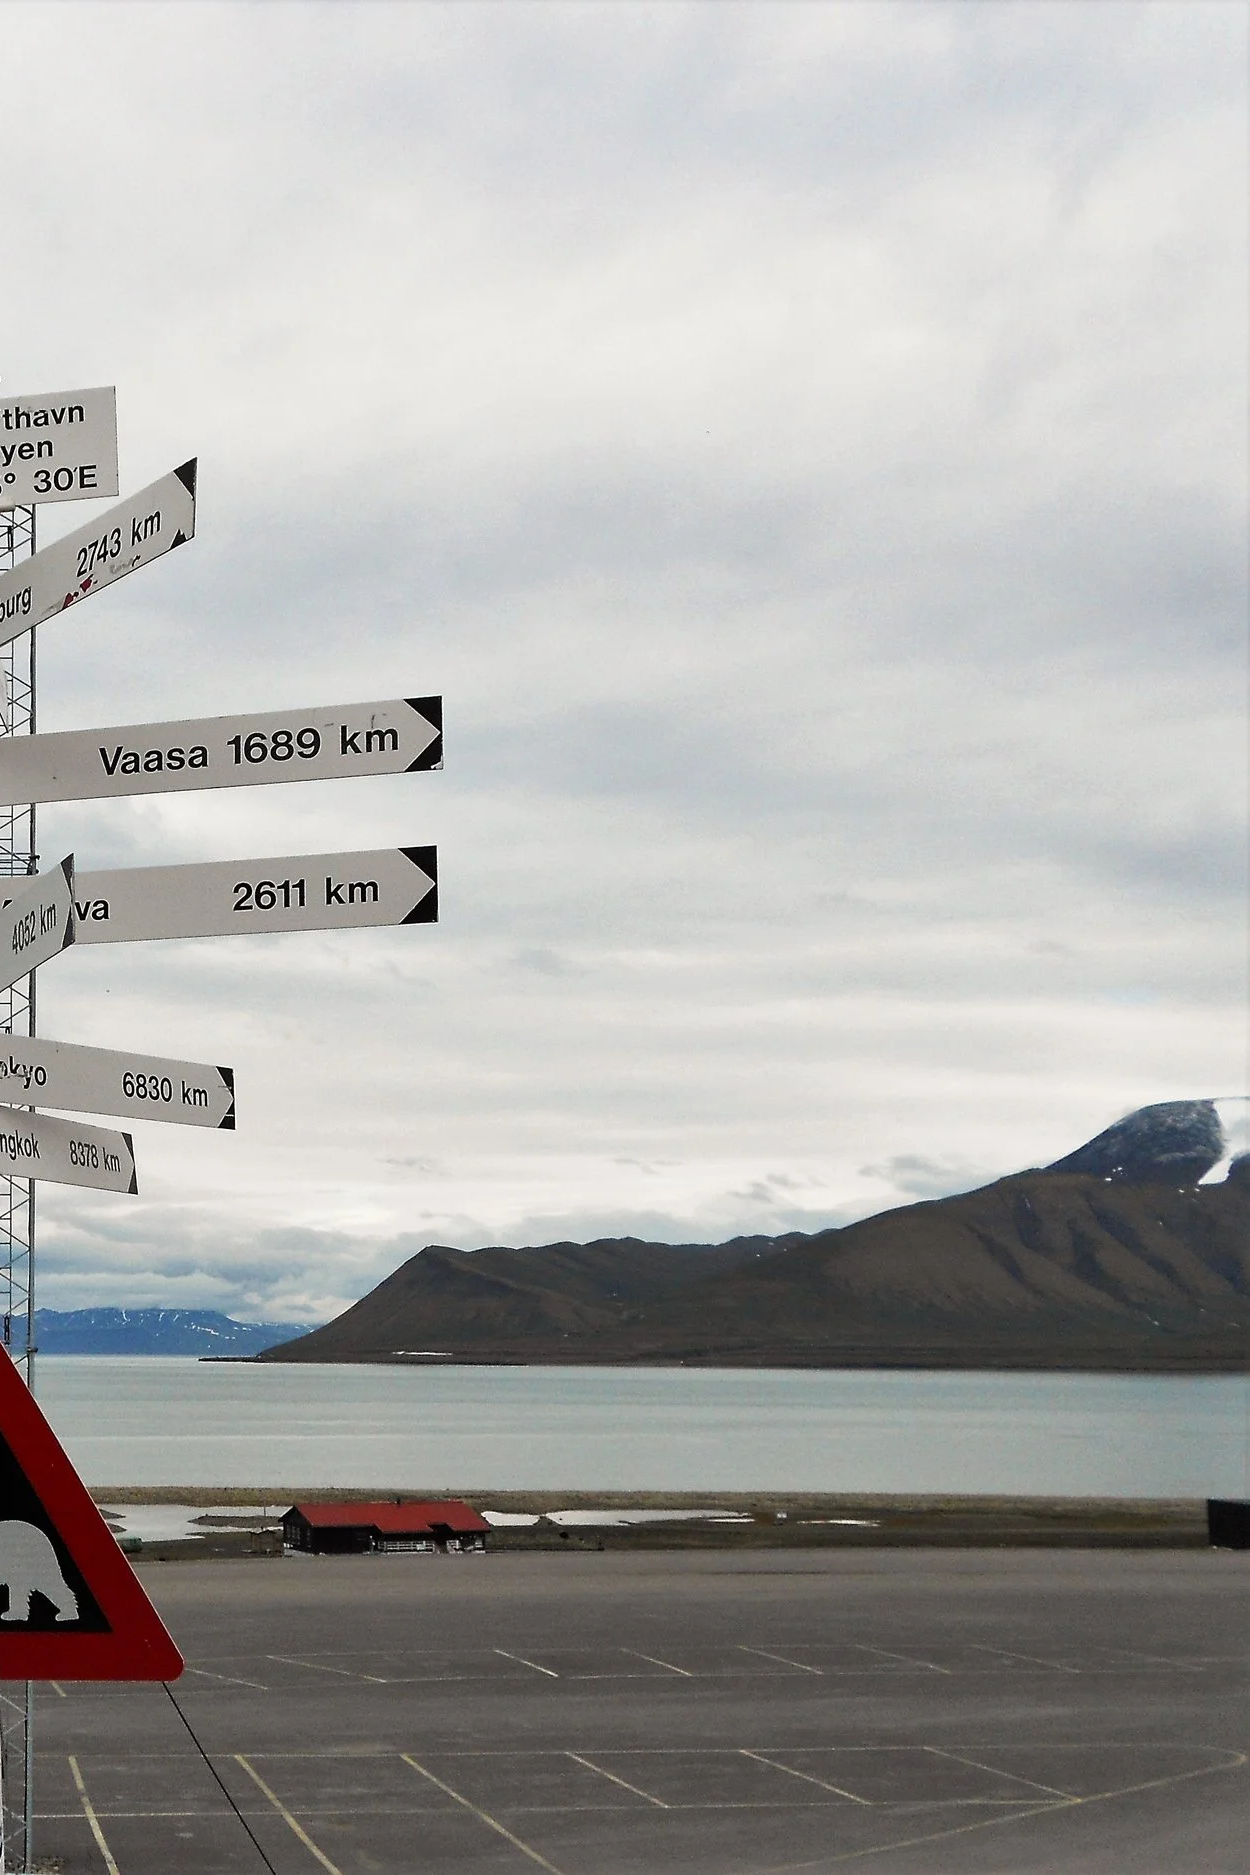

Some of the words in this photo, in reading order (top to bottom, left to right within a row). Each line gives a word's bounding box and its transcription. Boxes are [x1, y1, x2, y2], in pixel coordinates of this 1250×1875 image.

[76, 527, 122, 577] 2743
[131, 511, 161, 546] km
[99, 744, 209, 776] Vaasa
[226, 727, 321, 765] 1689
[340, 725, 399, 755] km
[232, 877, 307, 912] 2611
[325, 876, 379, 905] km
[12, 910, 36, 954] 4052
[40, 903, 57, 936] km
[123, 1071, 172, 1102] 6830
[182, 1080, 208, 1107] km
[70, 1140, 99, 1169] 8378
[103, 1147, 121, 1173] km
